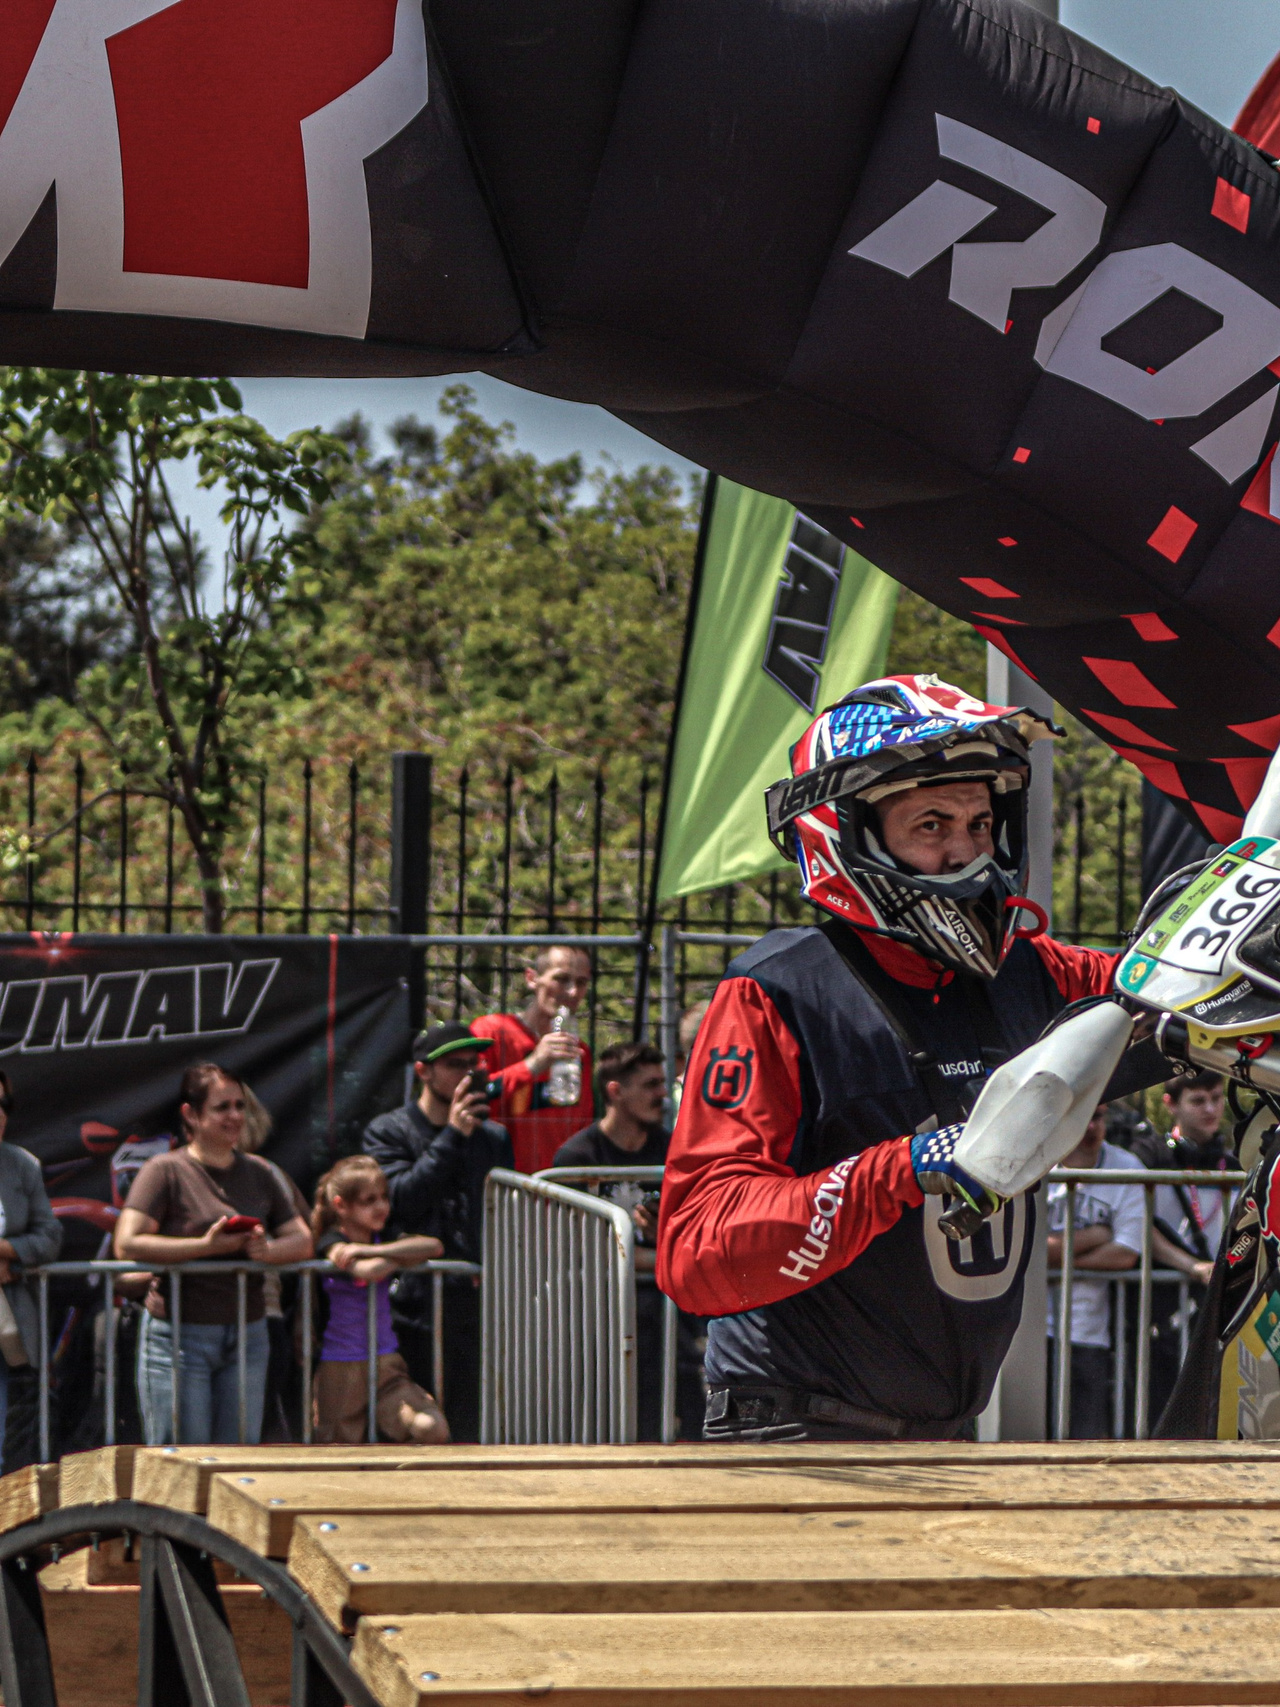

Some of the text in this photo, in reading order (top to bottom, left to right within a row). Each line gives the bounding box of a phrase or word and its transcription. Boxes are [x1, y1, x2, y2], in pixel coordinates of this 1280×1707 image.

[826, 893, 851, 911] ACE 2
[944, 909, 978, 955] AIROH
[1206, 979, 1252, 1010] Husqvarna
